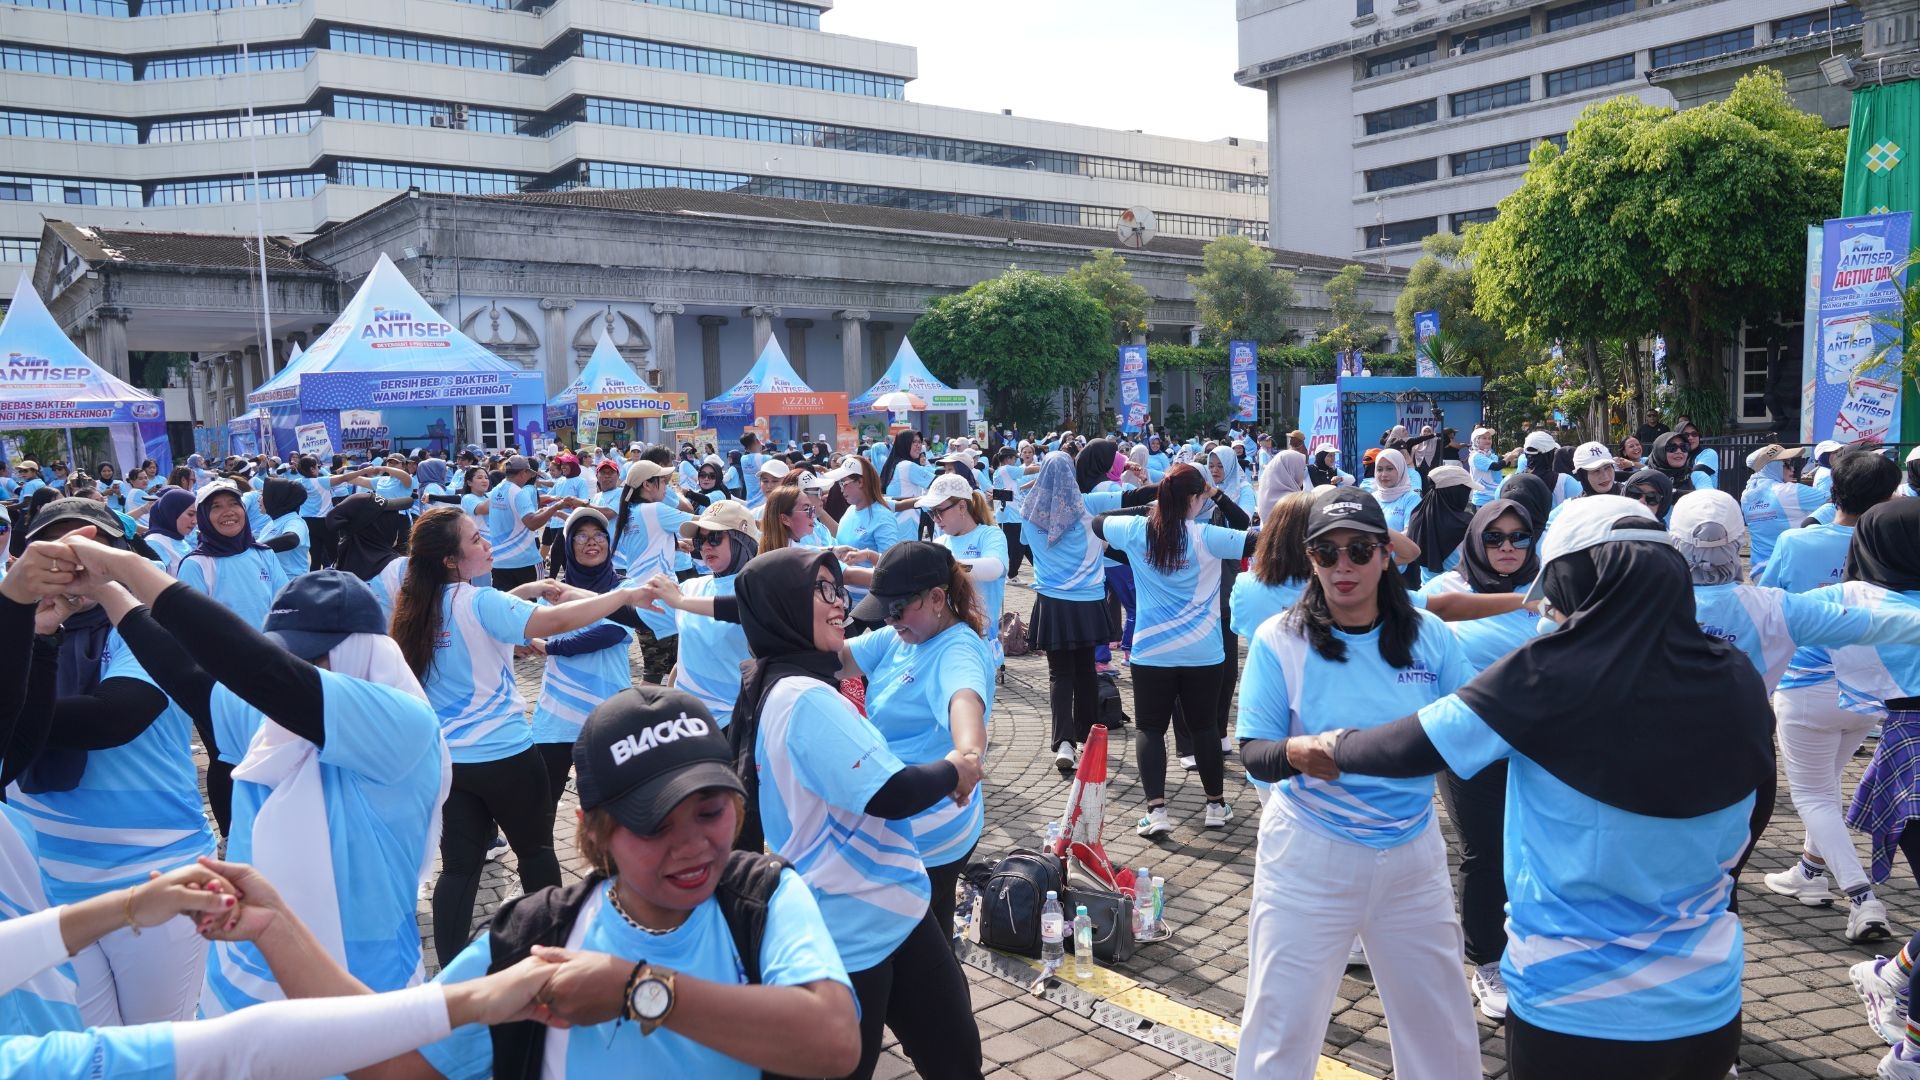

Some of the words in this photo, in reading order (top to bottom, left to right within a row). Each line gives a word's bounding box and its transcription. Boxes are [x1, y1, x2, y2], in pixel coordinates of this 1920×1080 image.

[1841, 252, 1892, 267] ANTISEP
[1835, 268, 1875, 289] ACTIVE
[1875, 265, 1893, 280] DAY
[375, 309, 412, 321] Klin
[361, 322, 451, 340] ANTISEP
[1827, 337, 1872, 353] ANTISEP
[8, 355, 49, 367] Klin
[0, 368, 91, 381] ANTISEP
[380, 377, 419, 390] BERSIH
[420, 376, 454, 388] BEBAS
[455, 374, 498, 385] BAKTERI
[373, 390, 408, 402] WANGI
[410, 388, 441, 400] MESKI
[443, 384, 511, 397] BERKERINGAT
[1, 401, 33, 410] BEBAS
[35, 401, 76, 409] BAKTERI
[597, 400, 671, 411] HOUSEHOLD
[782, 396, 824, 405] AZZURA
[0, 412, 16, 421] NGI
[18, 411, 48, 420] MESKI
[49, 408, 114, 419] BERKERINGAT
[1844, 401, 1891, 418] ANTISEP
[341, 426, 388, 439] ANTISEP
